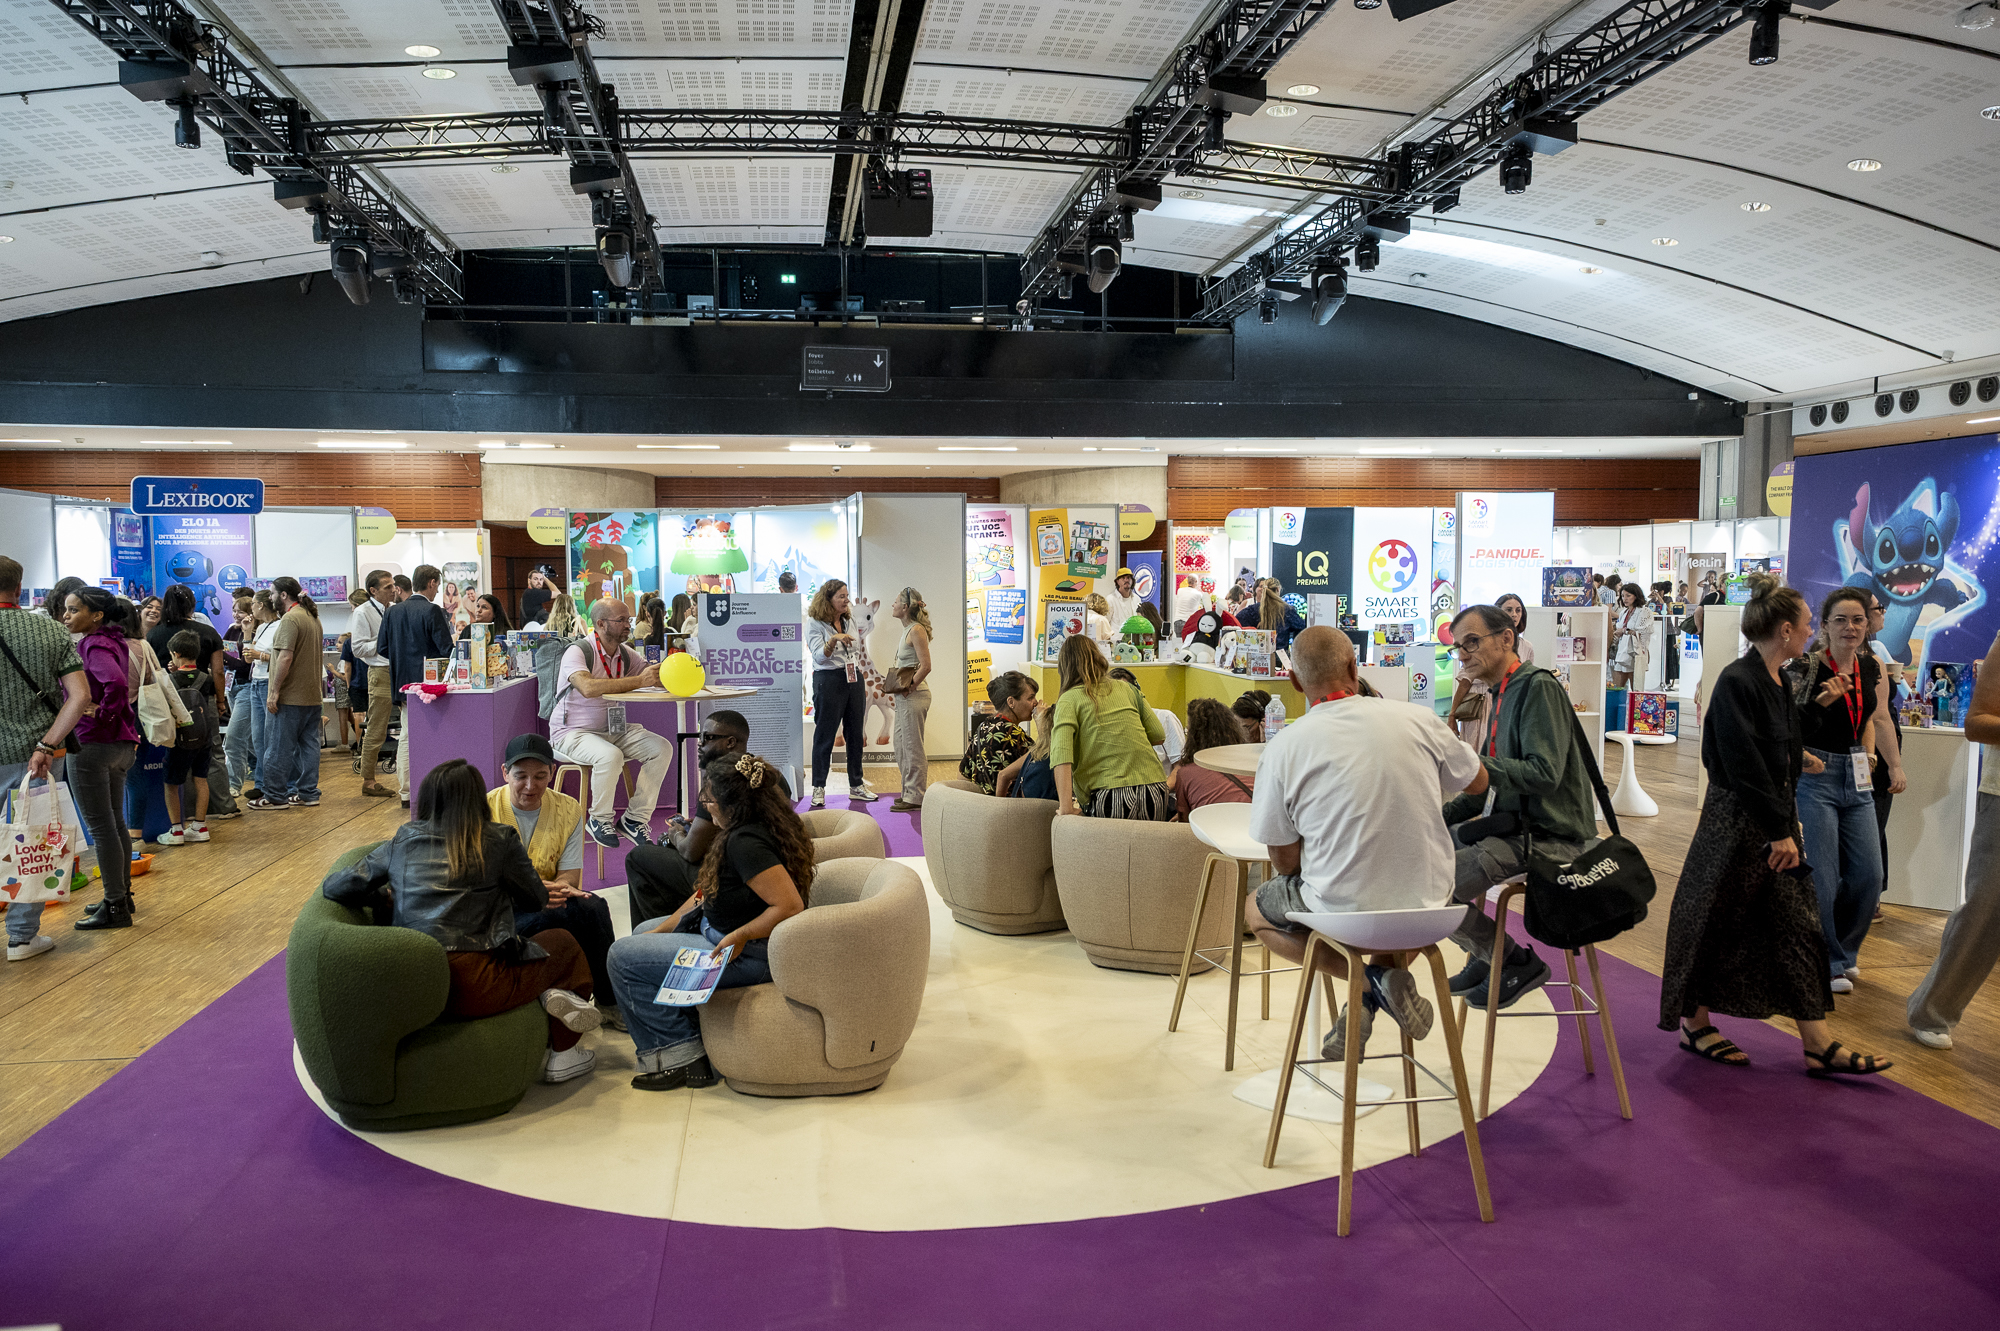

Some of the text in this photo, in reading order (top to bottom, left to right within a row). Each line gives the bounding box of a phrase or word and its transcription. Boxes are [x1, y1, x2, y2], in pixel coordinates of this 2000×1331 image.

[182, 518, 220, 526] ELO IA
[1297, 551, 1329, 577] IQ
[444, 571, 480, 581] WOW
[1365, 597, 1418, 607] SMART
[1365, 608, 1419, 618] GAMES
[706, 648, 775, 662] ESPACE
[15, 844, 46, 855] Love
[20, 853, 54, 867] play,
[18, 863, 57, 876] learn.
